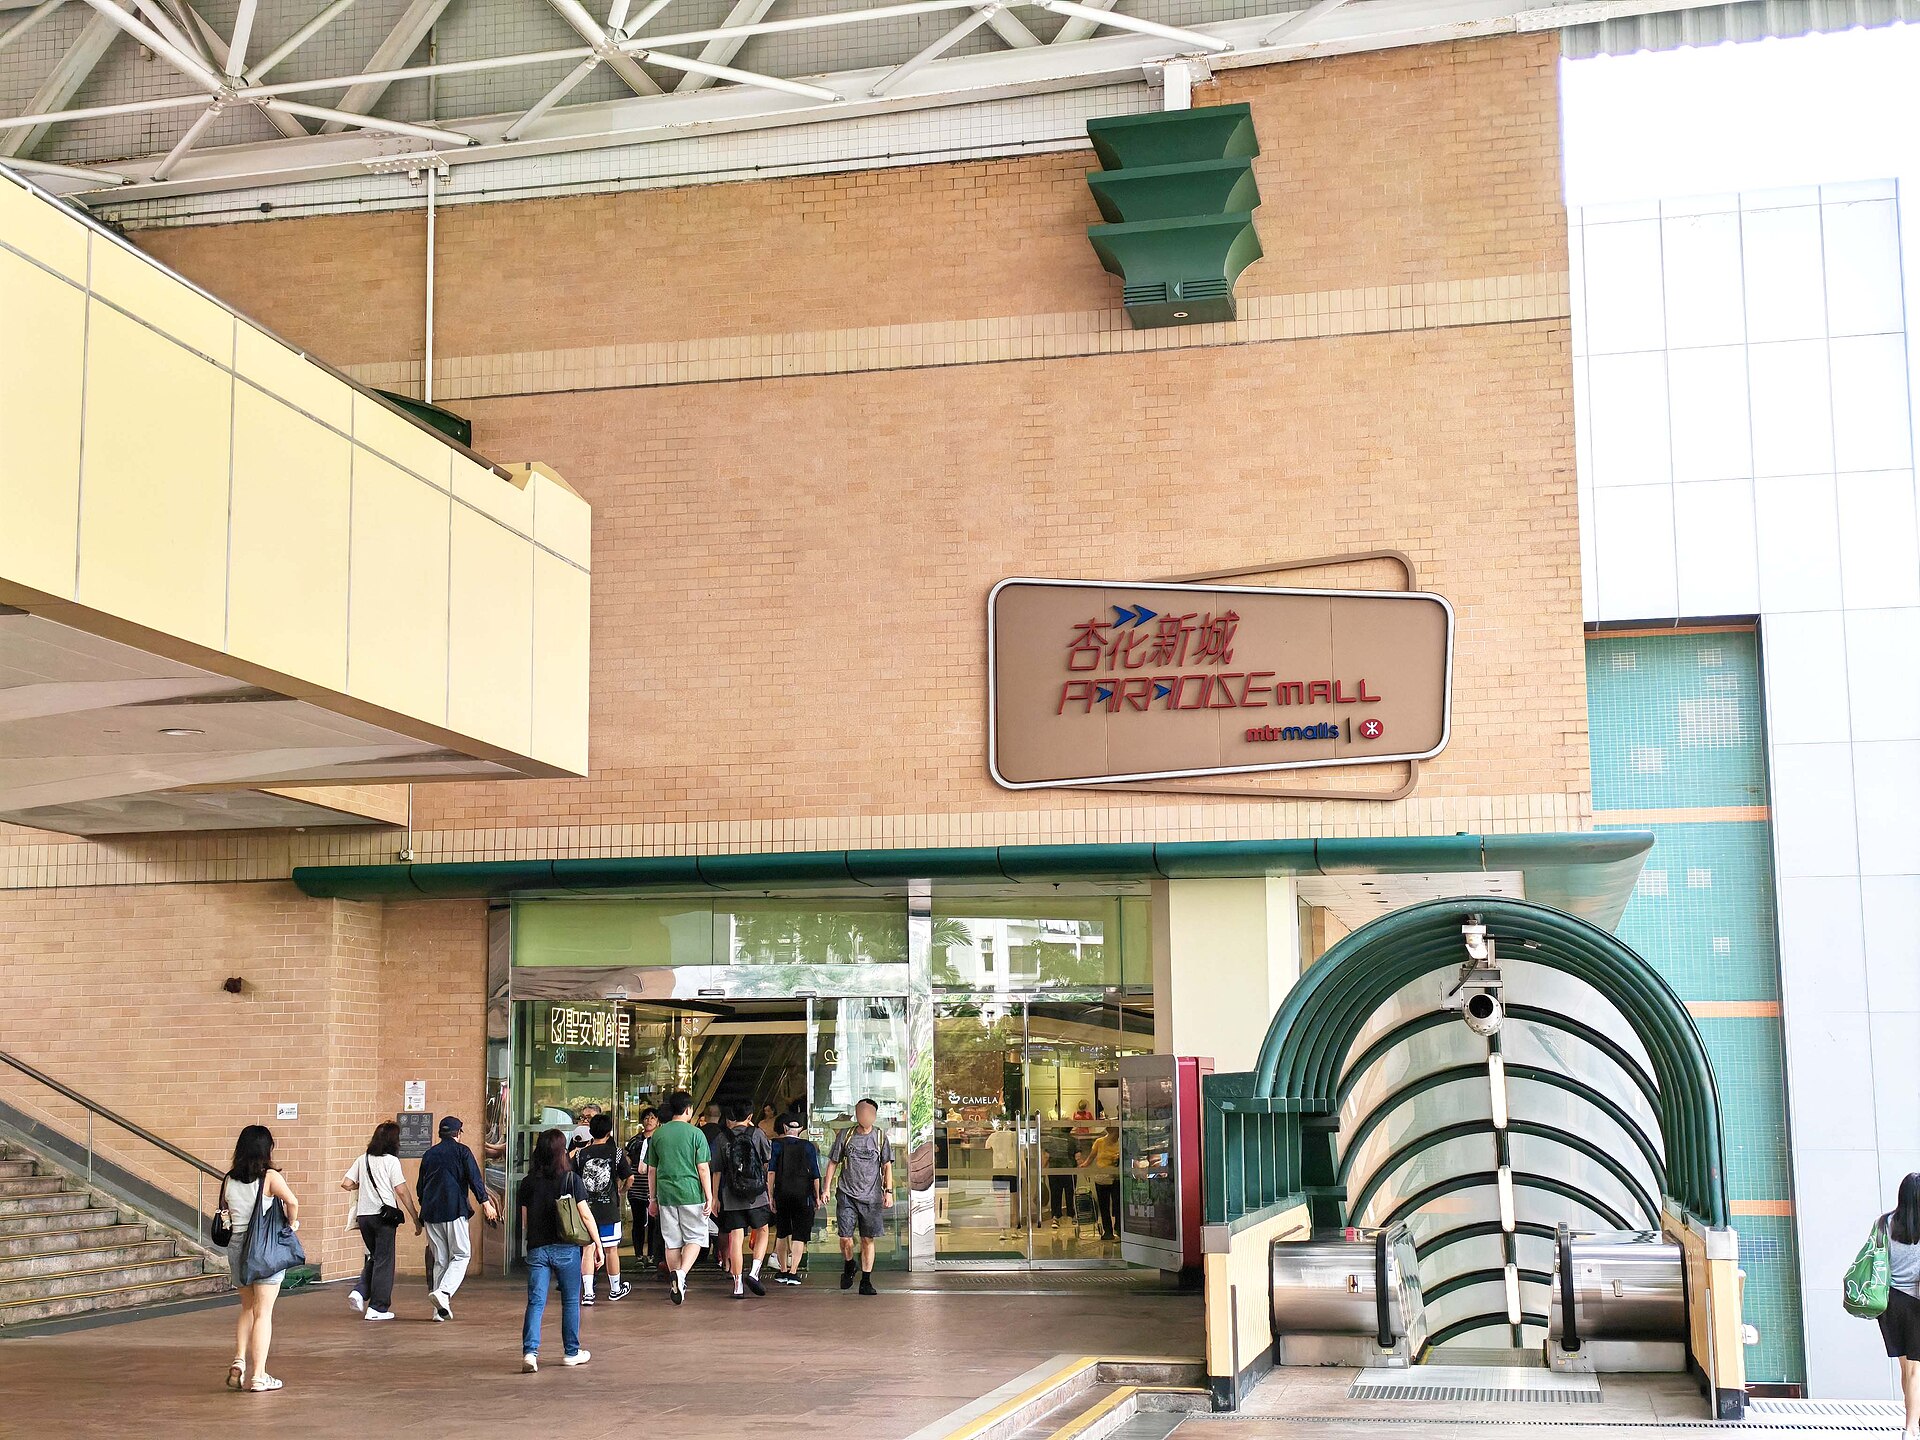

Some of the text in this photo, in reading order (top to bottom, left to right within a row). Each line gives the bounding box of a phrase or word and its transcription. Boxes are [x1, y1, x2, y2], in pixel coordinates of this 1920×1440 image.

[1056, 671, 1382, 715] PARADISE MALL
[1245, 721, 1340, 742] mtrmalls
[962, 1096, 999, 1105] CAMELA
